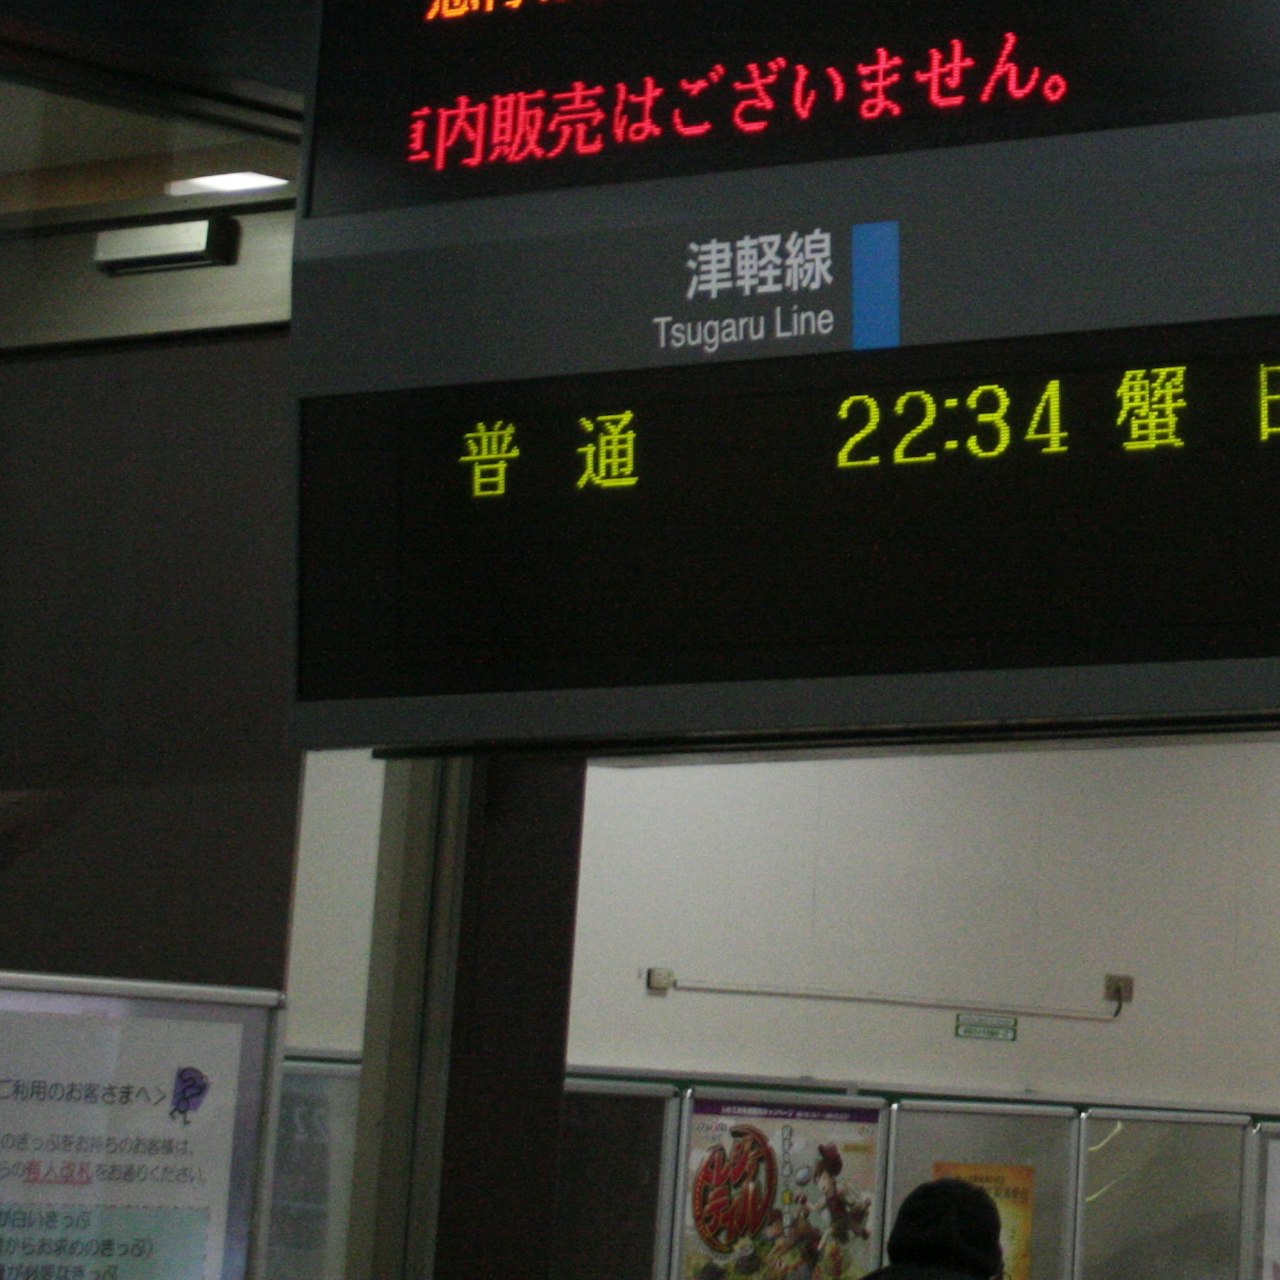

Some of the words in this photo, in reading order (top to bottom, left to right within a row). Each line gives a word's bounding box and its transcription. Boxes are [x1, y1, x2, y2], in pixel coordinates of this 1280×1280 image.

[685, 229, 833, 301] 津軽線
[653, 315, 766, 353] Tsugaru
[774, 305, 835, 339] Line
[460, 410, 638, 497] 普通
[837, 379, 1068, 468] 22:34
